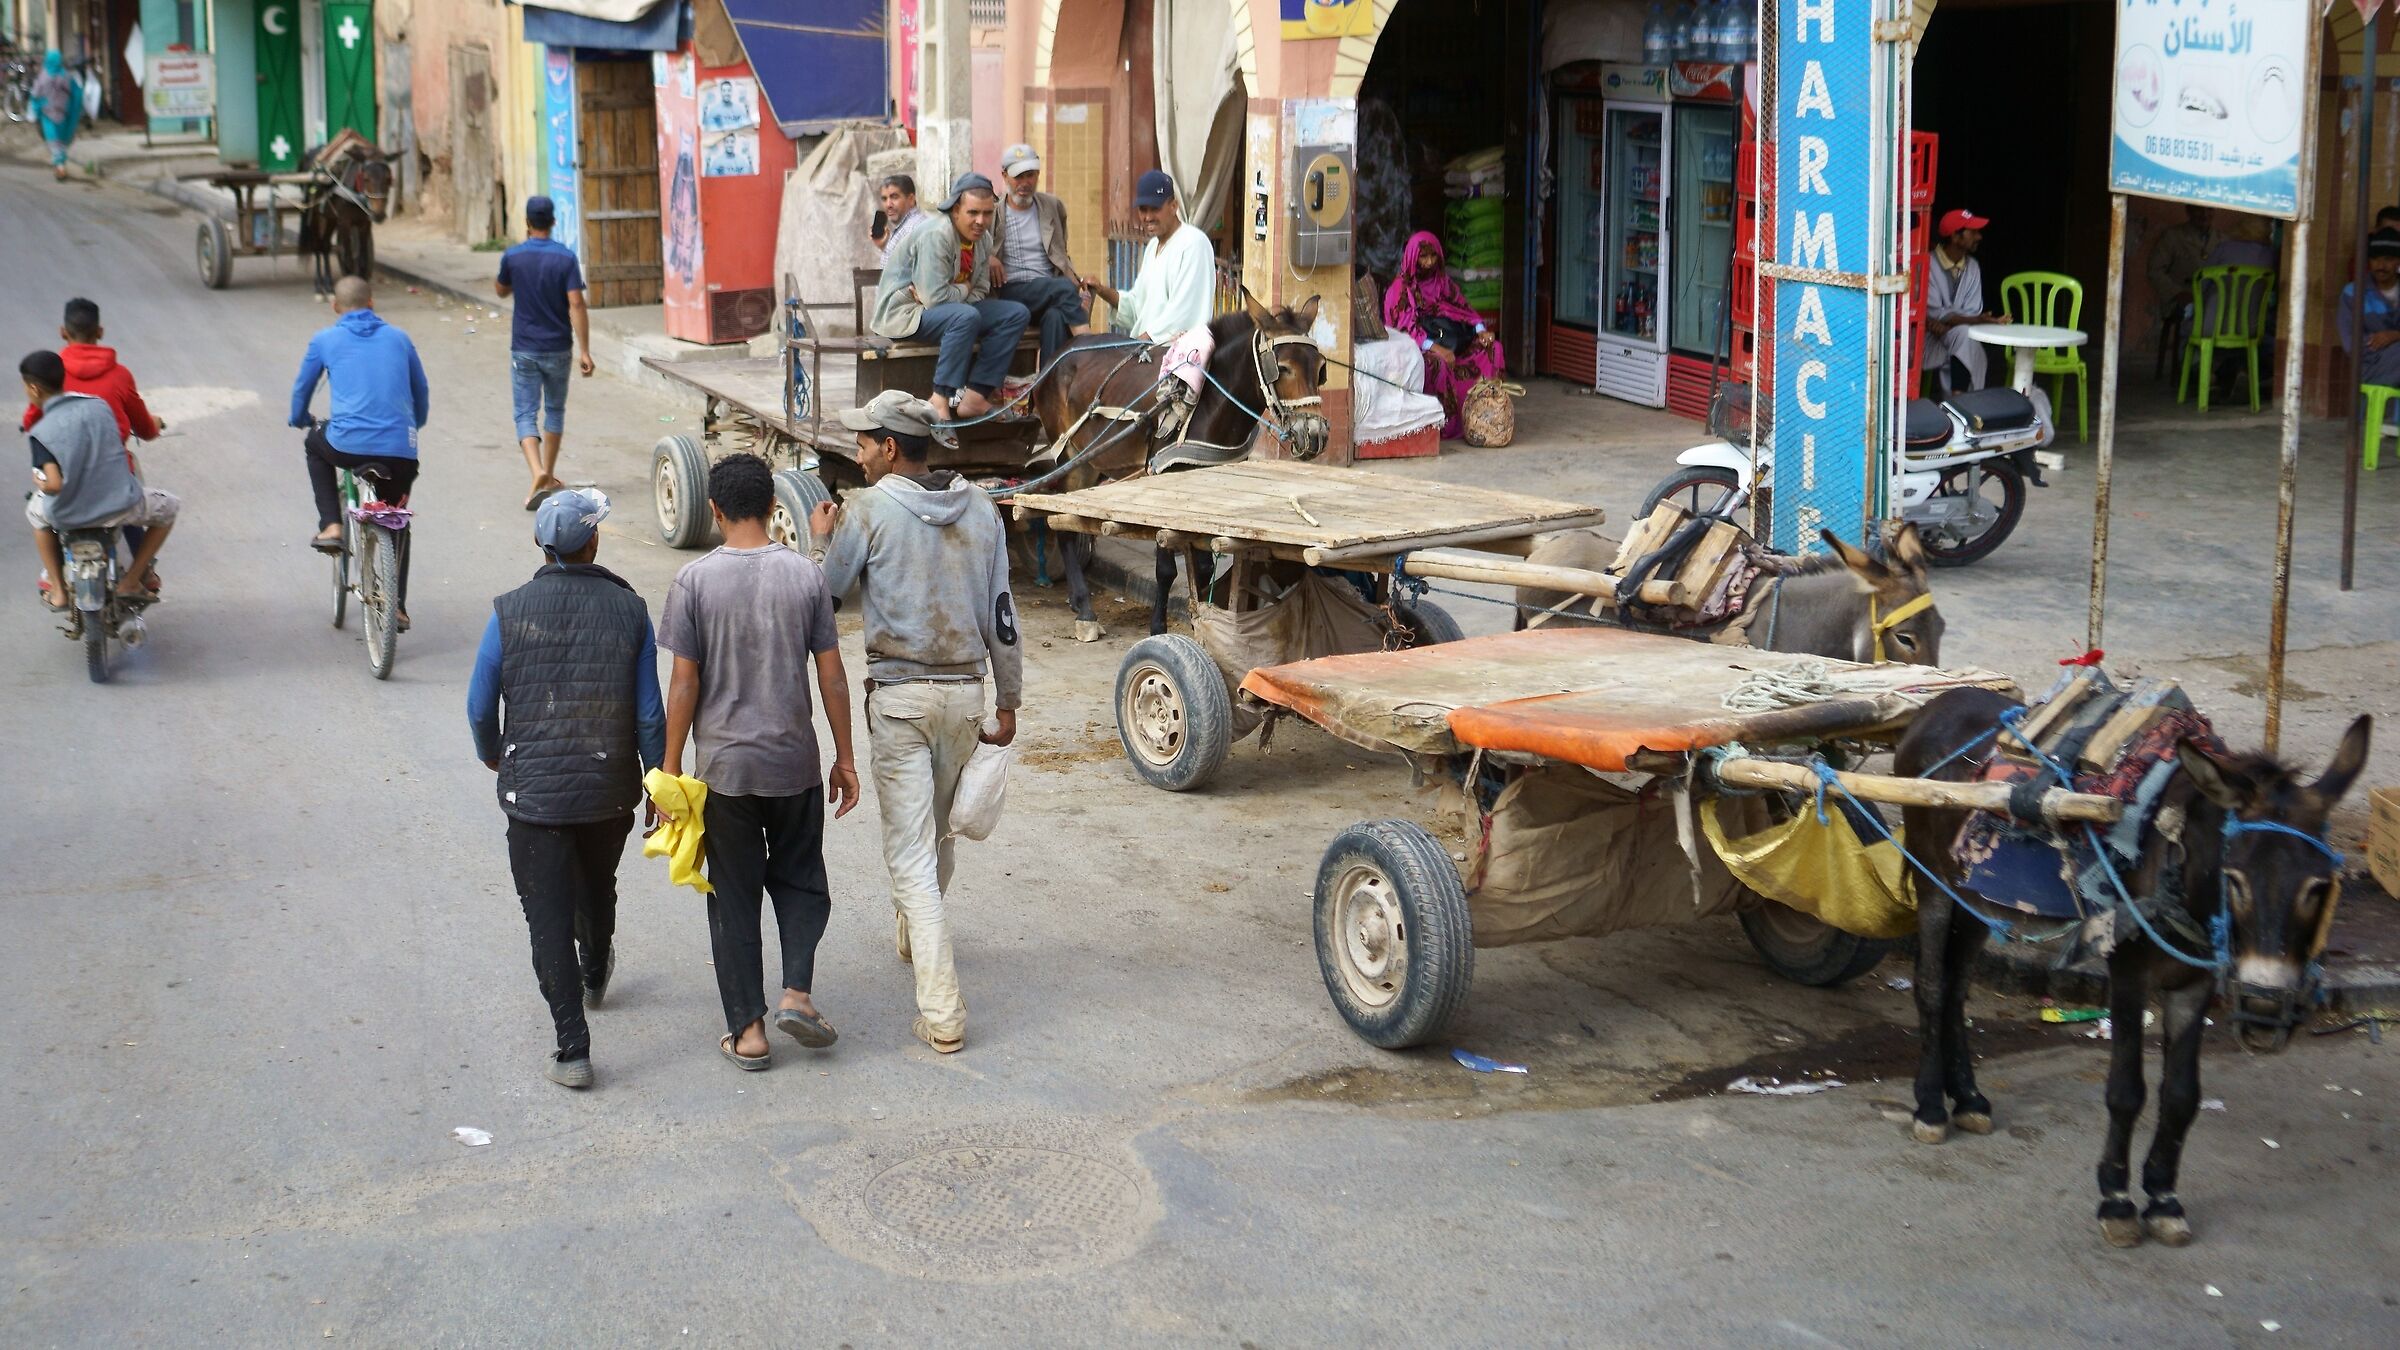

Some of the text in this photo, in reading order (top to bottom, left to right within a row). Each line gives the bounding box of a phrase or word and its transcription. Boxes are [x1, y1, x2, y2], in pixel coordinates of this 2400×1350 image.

[2163, 4, 2254, 57] الأسنان
[2145, 135, 2157, 154] 06
[2173, 138, 2185, 158] 83
[2201, 142, 2214, 162] 31
[2218, 146, 2245, 168] رشيد
